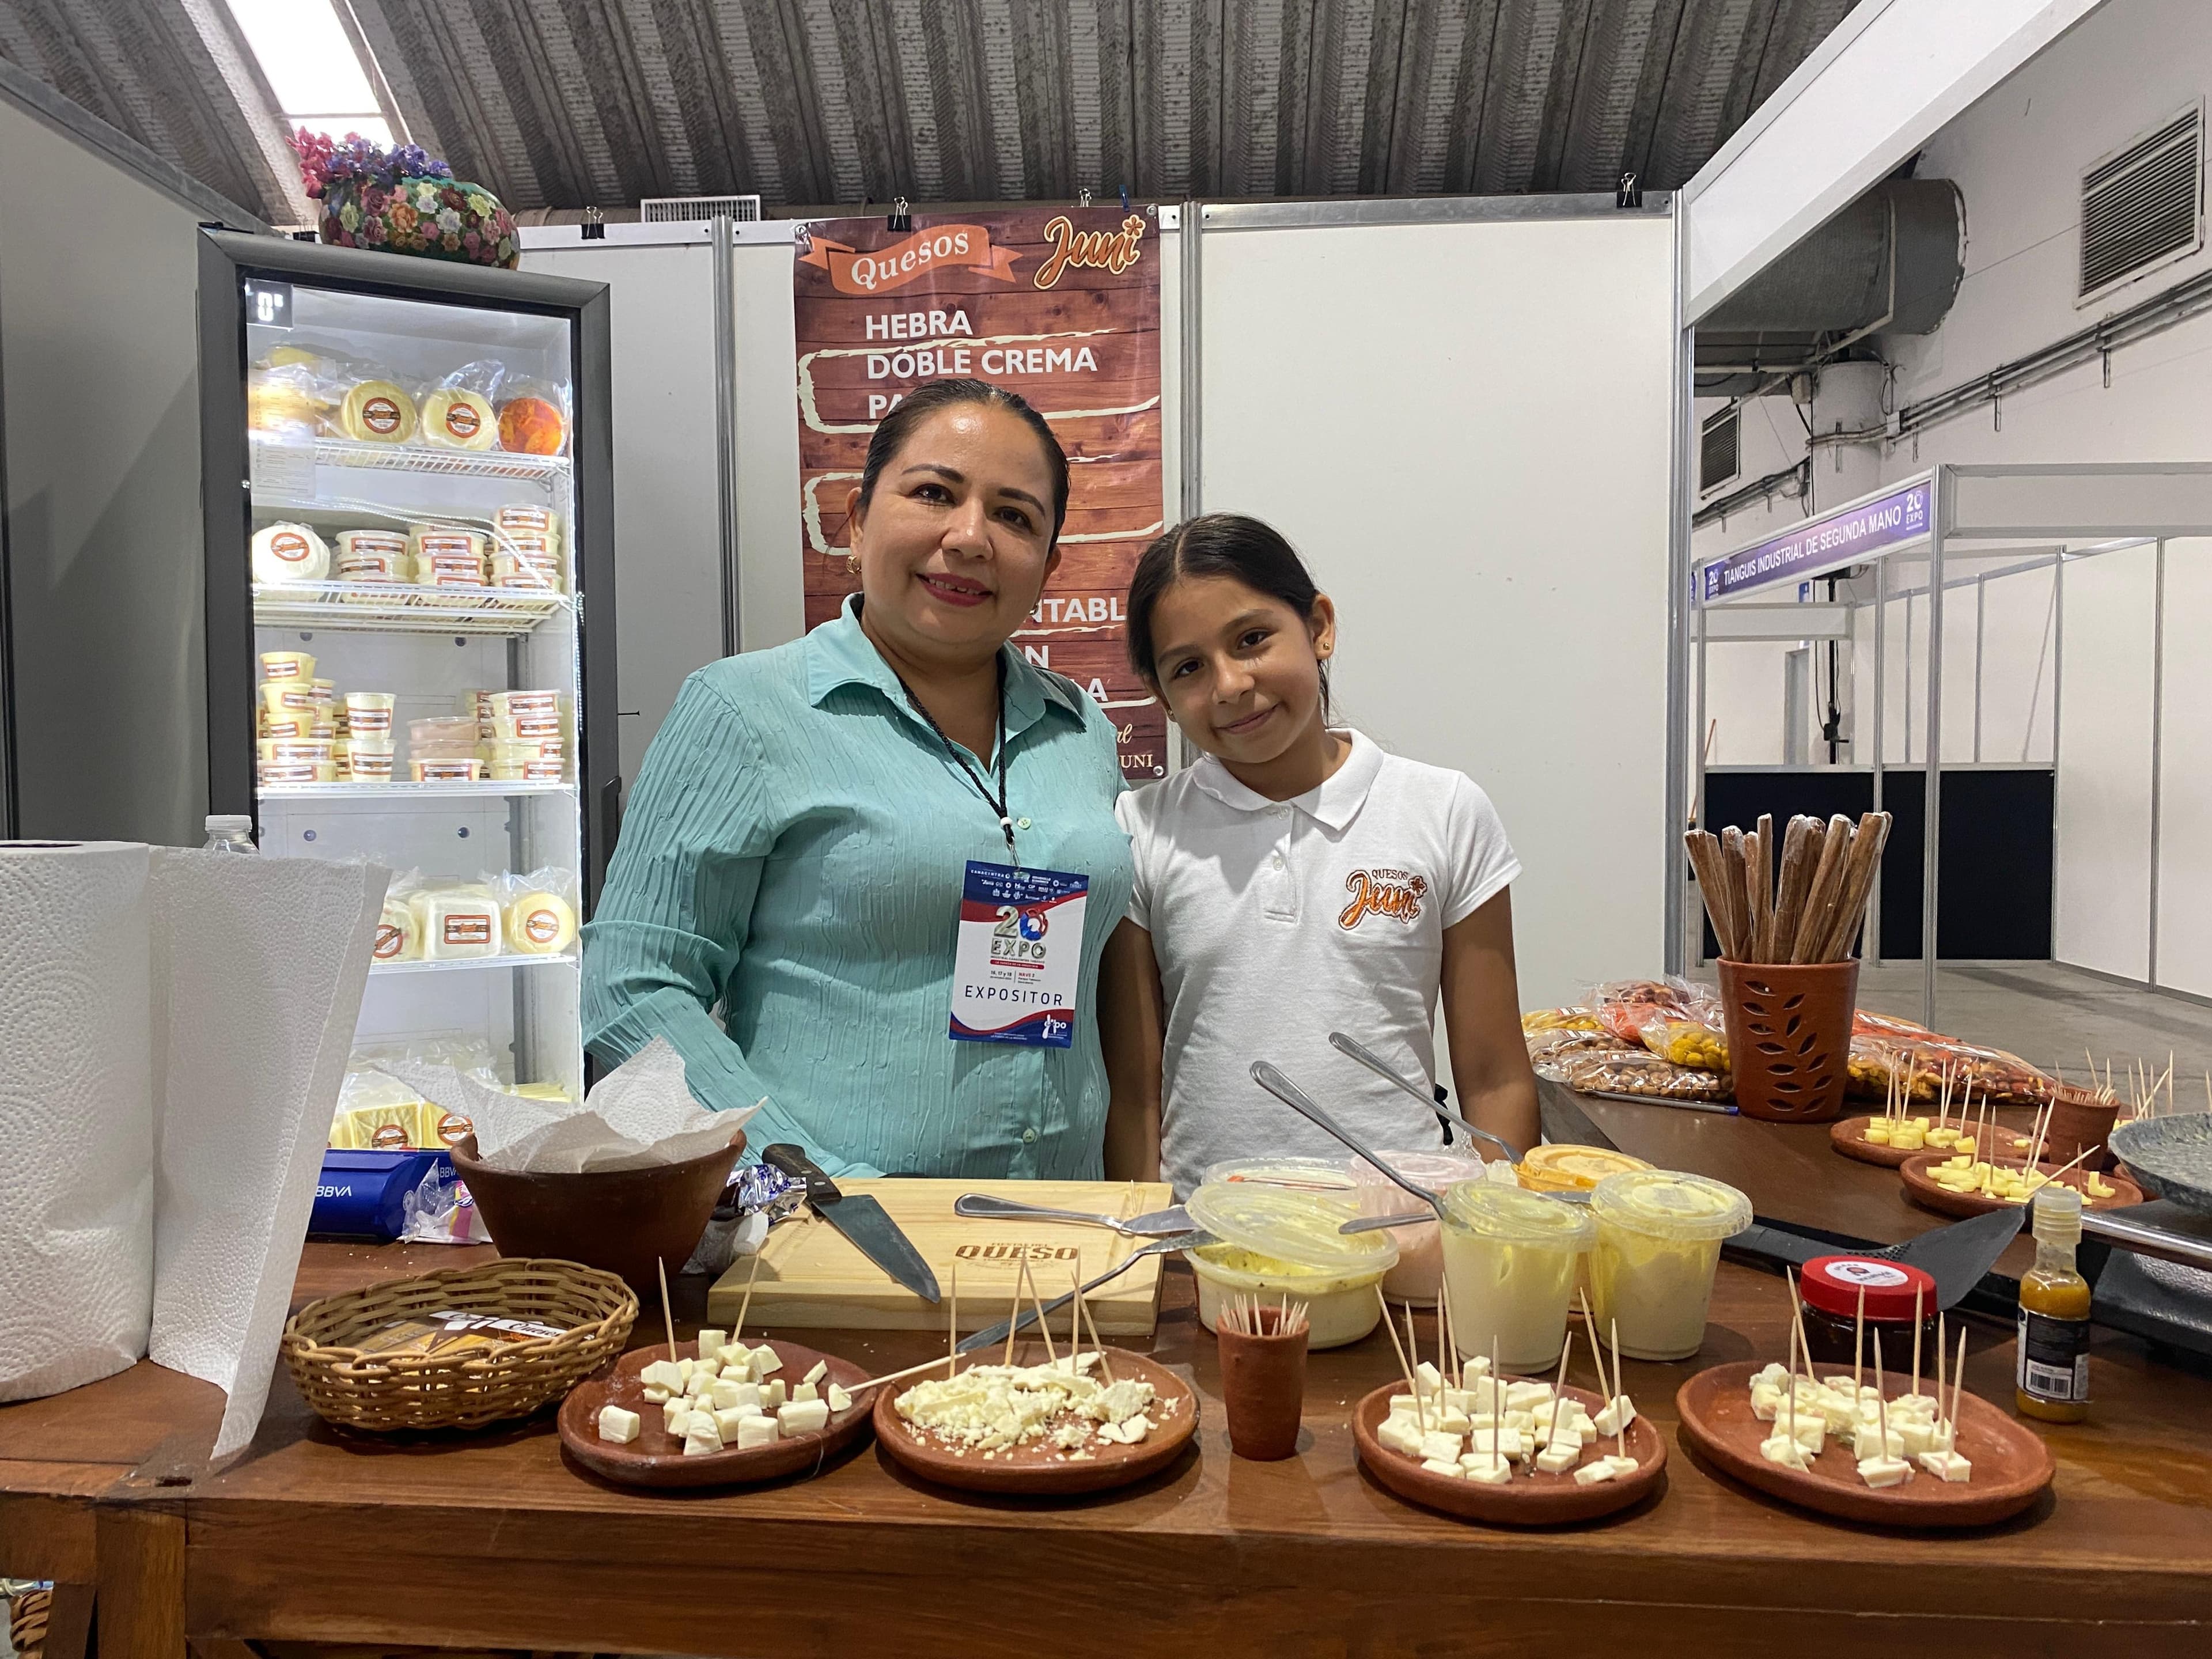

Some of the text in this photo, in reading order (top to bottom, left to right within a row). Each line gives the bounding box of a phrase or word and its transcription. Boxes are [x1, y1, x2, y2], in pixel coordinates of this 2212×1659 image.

[851, 232, 969, 290] Quesos
[1033, 214, 1146, 289] Juni
[865, 310, 973, 339] HEBRA
[867, 347, 1098, 379] DOBLE CREMA
[1907, 490, 1923, 513] 20
[1906, 510, 1923, 525] EXPO
[1724, 505, 1902, 585] TIANGUIS INDUSTRIAL DE SEGUNDA MANO
[1372, 869, 1409, 880] QUESOS
[1338, 870, 1427, 930] Juni
[994, 906, 1048, 941] 20
[991, 938, 1047, 959] EXPO
[964, 985, 1063, 1006] EXPOSITOR
[315, 1185, 352, 1198] BBVA
[955, 1245, 1079, 1260] QUESO
